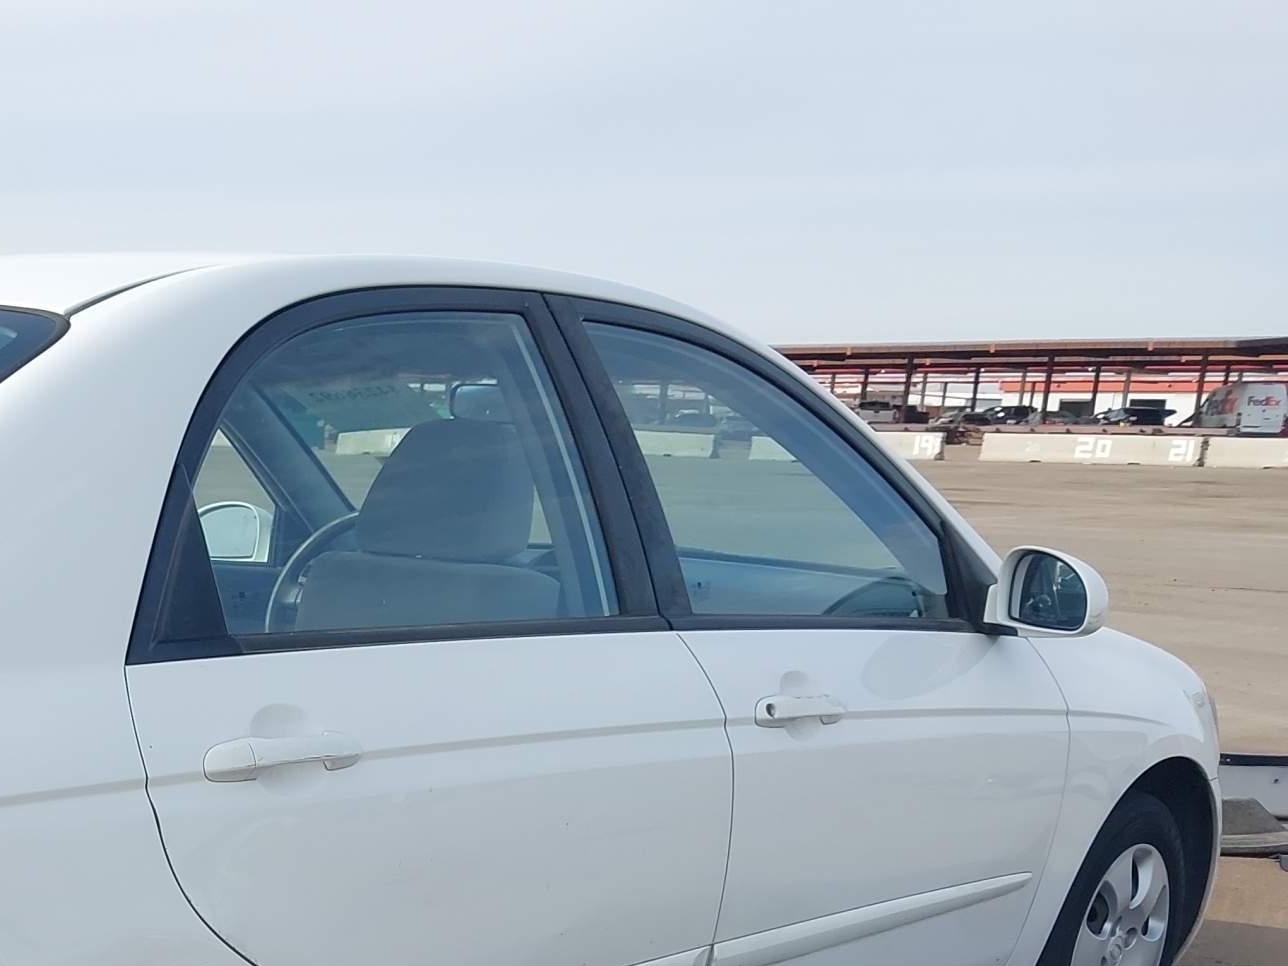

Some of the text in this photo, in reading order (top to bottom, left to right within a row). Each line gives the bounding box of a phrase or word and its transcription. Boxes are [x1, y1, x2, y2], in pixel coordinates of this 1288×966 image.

[1247, 396, 1281, 406] FedEx
[1074, 437, 1112, 459] 20
[1167, 439, 1195, 462] 21
